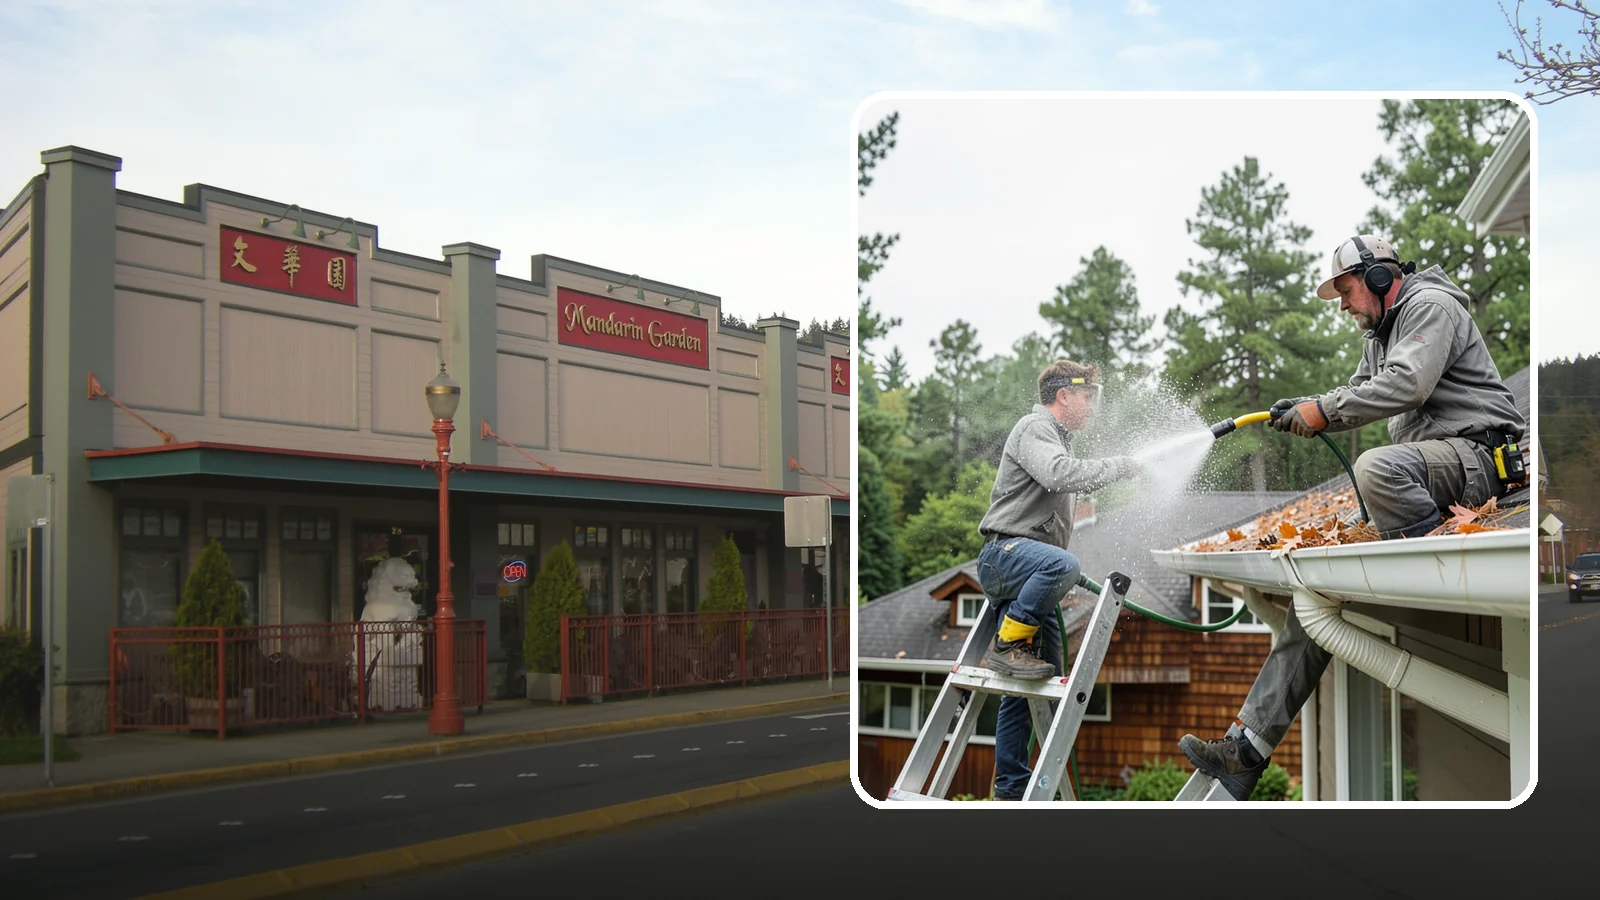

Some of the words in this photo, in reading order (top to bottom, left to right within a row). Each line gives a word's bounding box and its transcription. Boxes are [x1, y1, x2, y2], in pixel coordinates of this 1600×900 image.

[230, 235, 347, 291] 文華園
[564, 302, 644, 341] Mandarin
[647, 320, 702, 352] Garden
[503, 565, 527, 578] OPEN
